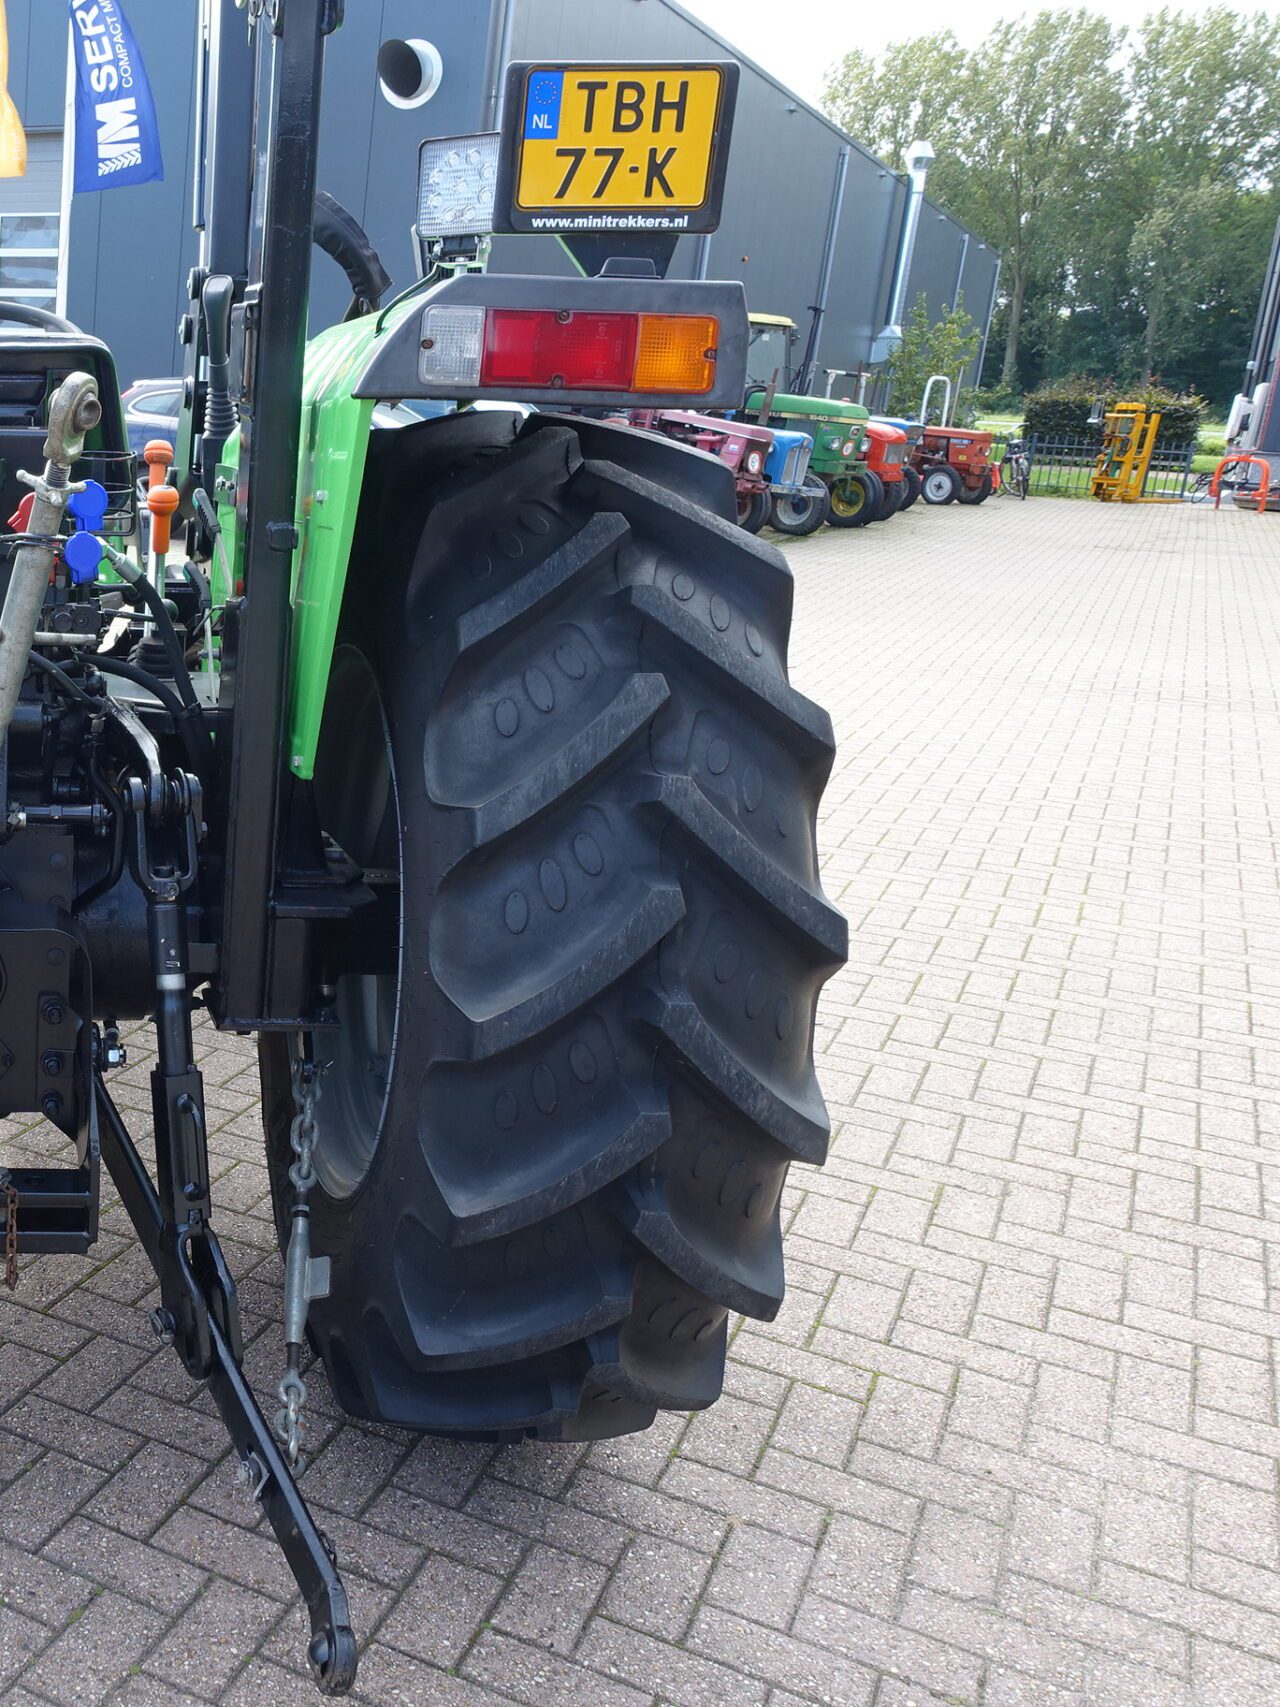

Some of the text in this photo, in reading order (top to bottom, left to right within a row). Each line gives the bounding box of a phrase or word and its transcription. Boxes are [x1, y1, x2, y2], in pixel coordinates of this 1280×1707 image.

[105, 15, 133, 88] COMPACT
[531, 113, 553, 129] NL
[576, 80, 689, 133] TBH
[553, 147, 678, 199] 77-K
[531, 214, 689, 229] www.minitrekkers.nl
